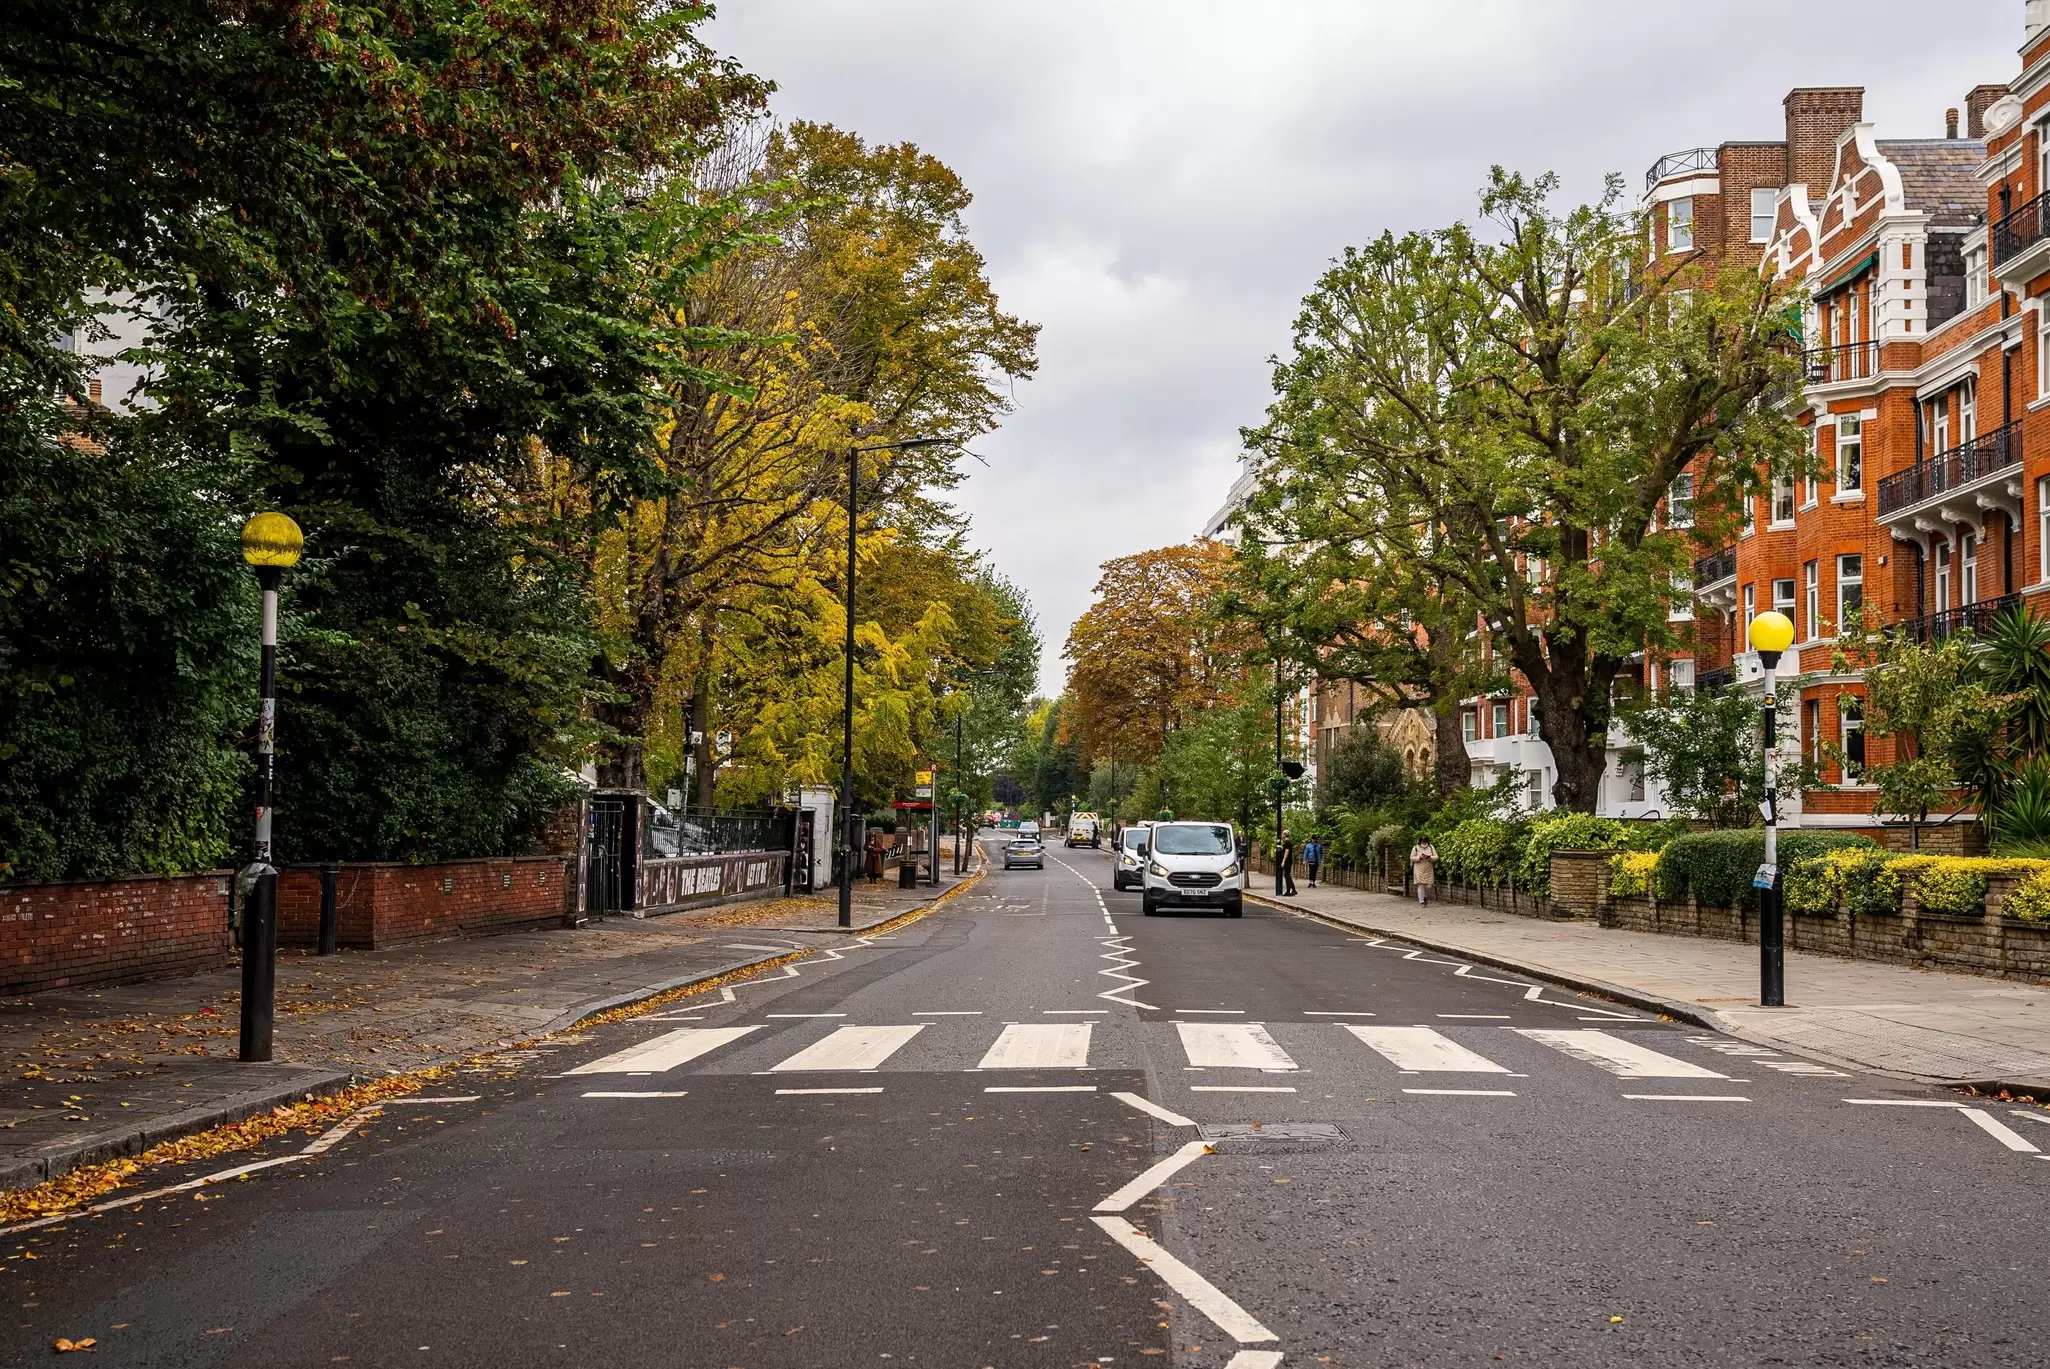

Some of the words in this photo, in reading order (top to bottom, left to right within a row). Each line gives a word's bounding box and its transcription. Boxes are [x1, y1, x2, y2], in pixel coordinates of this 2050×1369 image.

[681, 868, 697, 896] THE
[695, 866, 722, 894] BEATLES
[746, 863, 756, 886] LET
[754, 862, 762, 885] IT
[760, 861, 768, 884] BE
